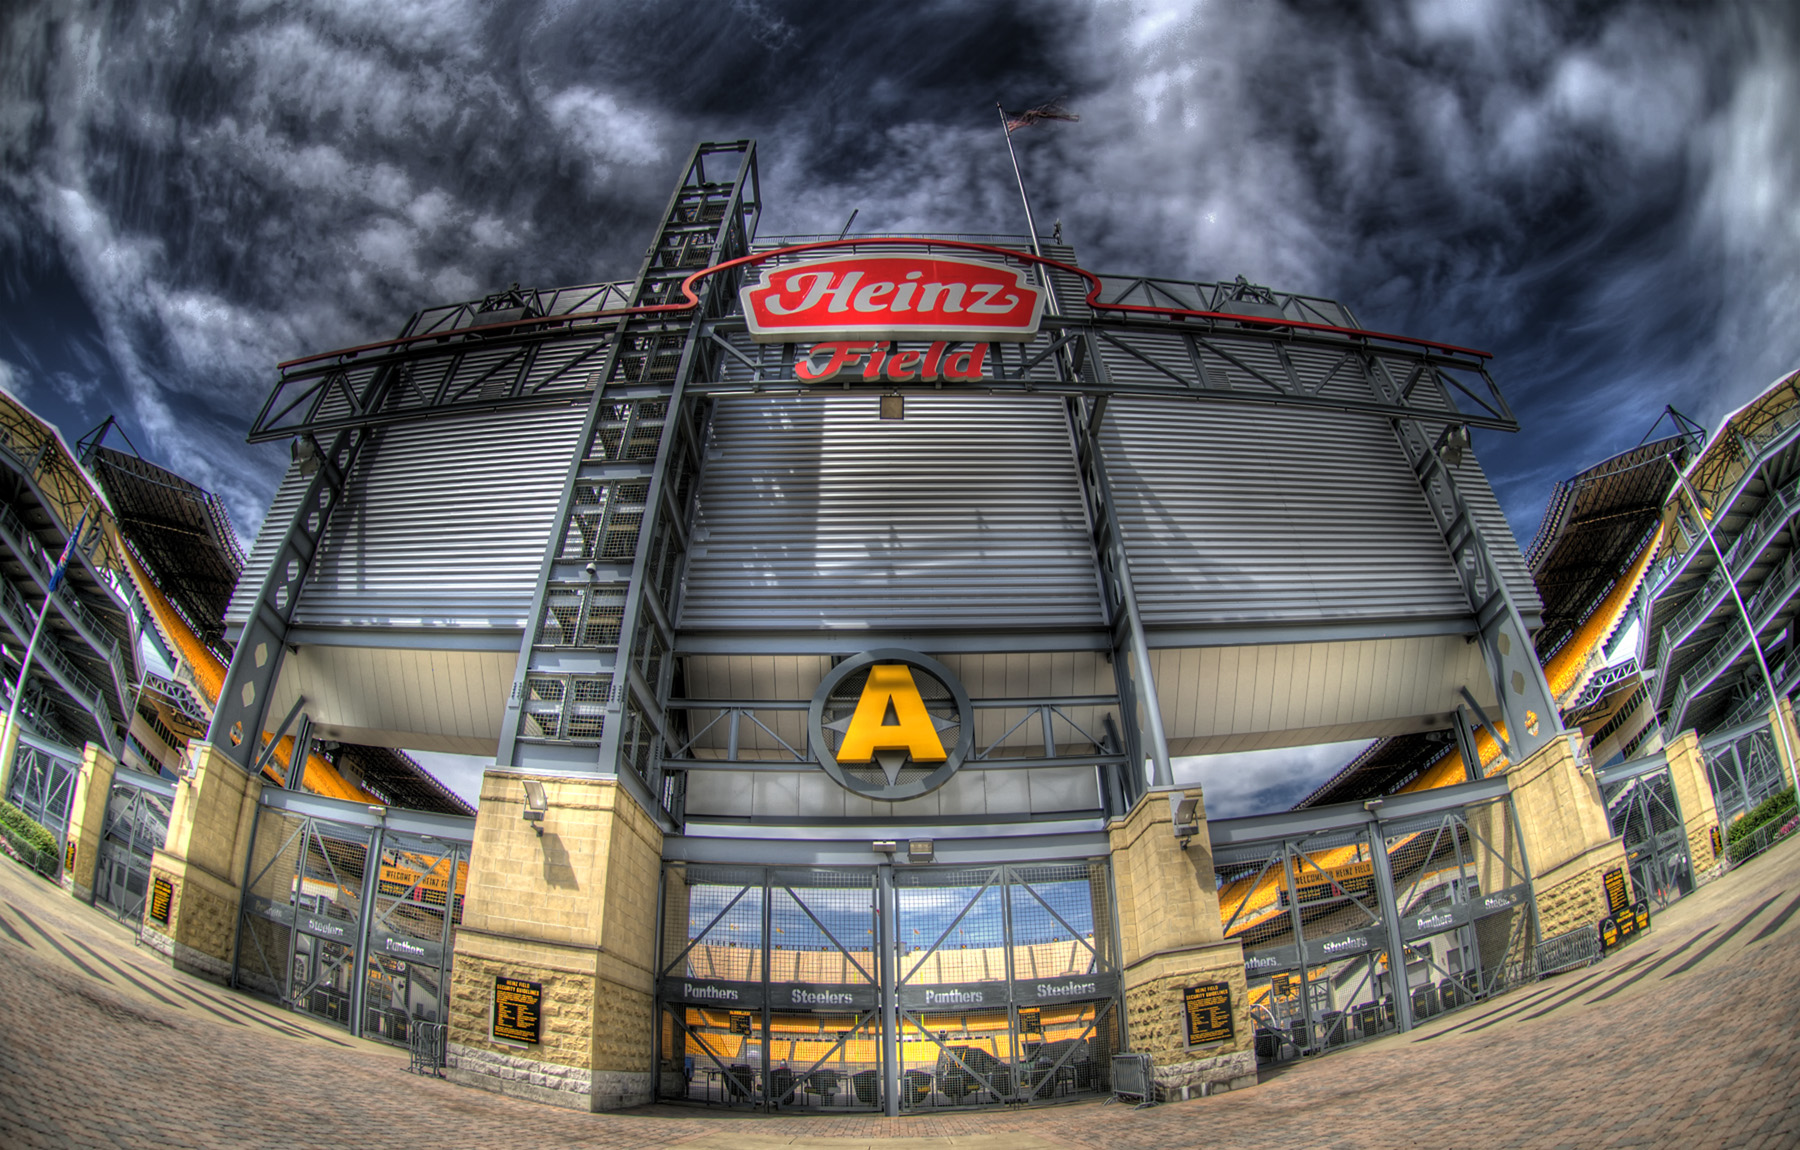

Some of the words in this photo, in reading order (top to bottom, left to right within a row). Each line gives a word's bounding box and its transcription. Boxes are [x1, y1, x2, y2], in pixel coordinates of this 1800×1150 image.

[765, 271, 1019, 315] Heinz
[794, 341, 989, 383] Field
[836, 665, 947, 763] A
[1335, 866, 1353, 877] HEINZ
[1354, 863, 1371, 874] FIELD
[308, 919, 344, 937] Steelers
[1417, 913, 1454, 930] Panthers
[386, 937, 425, 956] Panthers
[1323, 937, 1368, 953] Steelers
[1245, 956, 1278, 970] nthers
[684, 983, 738, 1000] Panthers
[791, 988, 853, 1004] Steelers
[926, 989, 983, 1004] Panthers
[1037, 981, 1096, 997] Steelers
